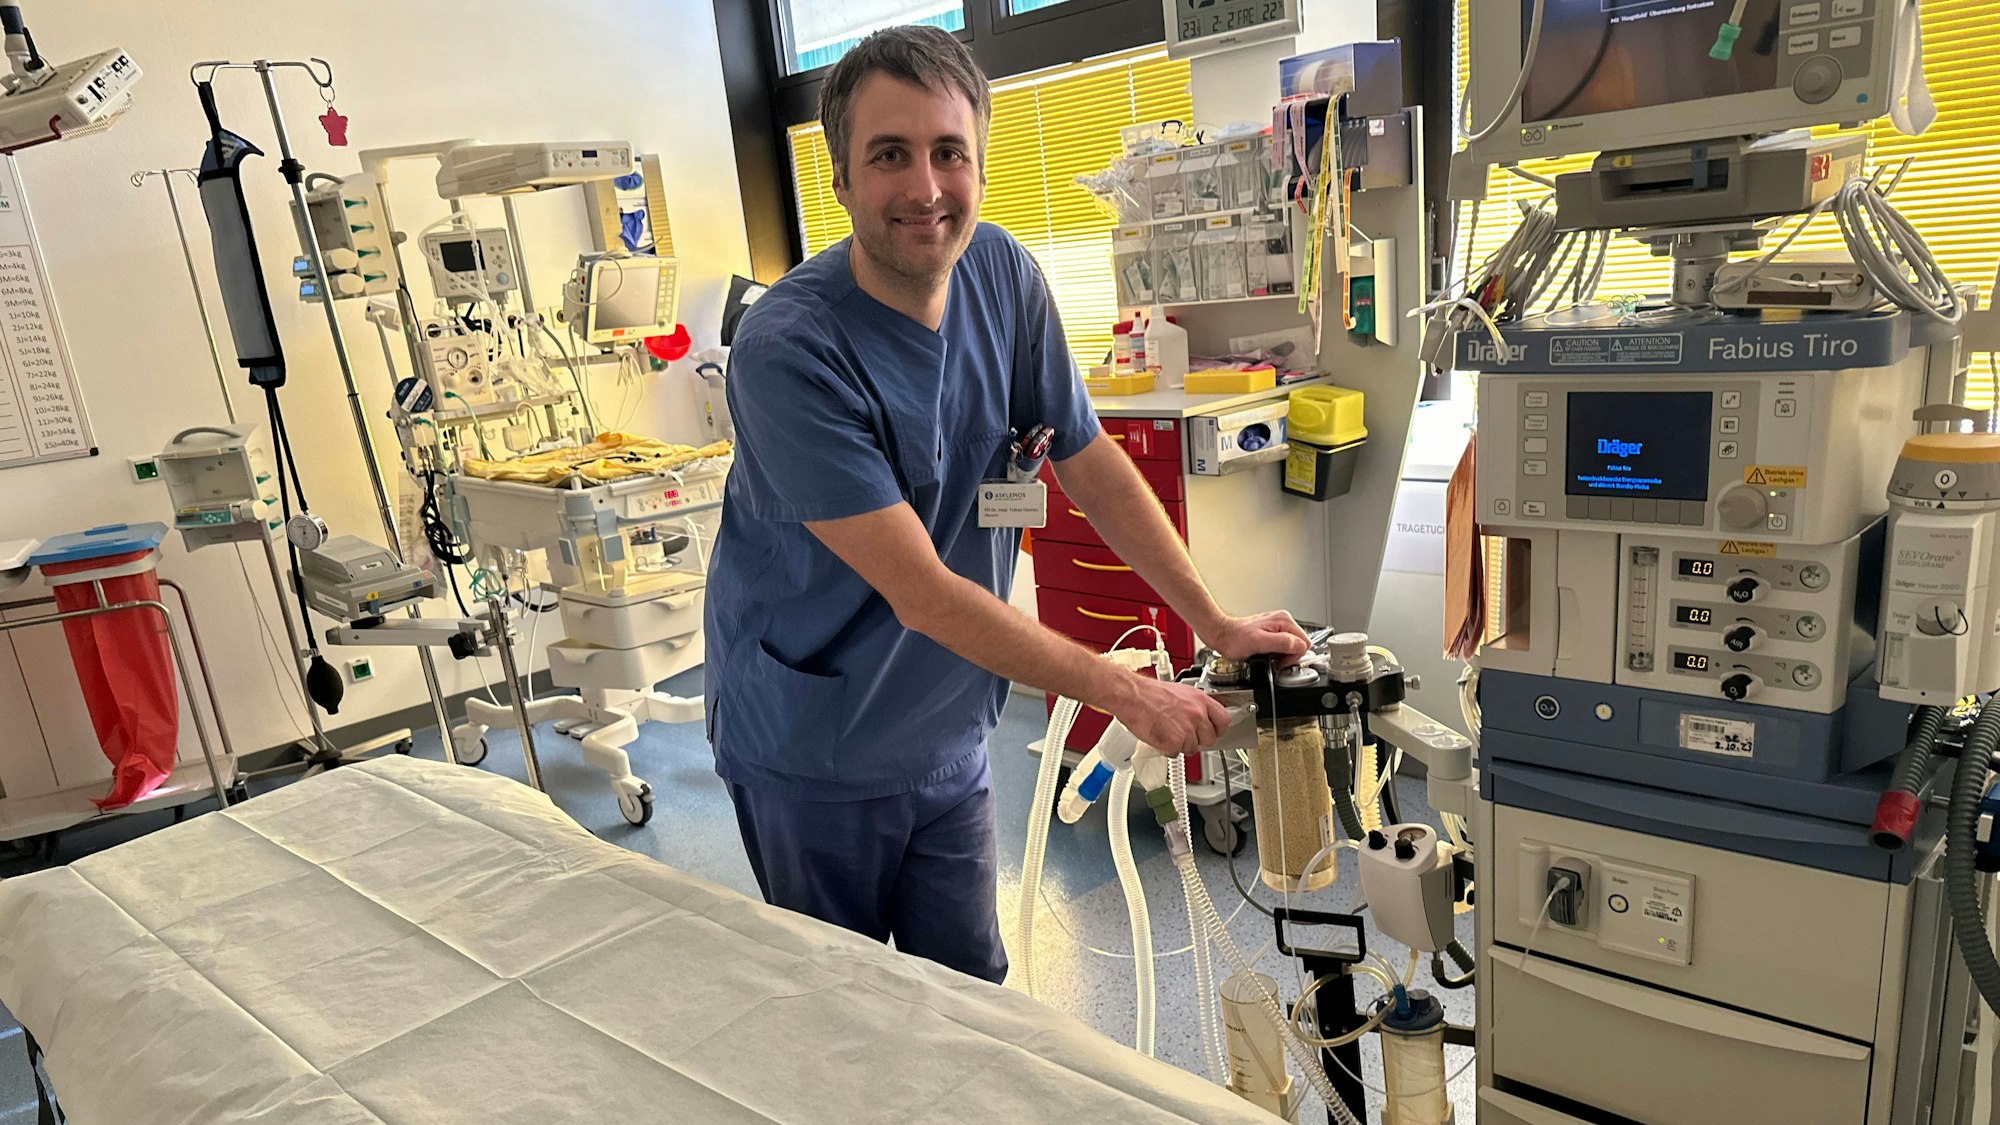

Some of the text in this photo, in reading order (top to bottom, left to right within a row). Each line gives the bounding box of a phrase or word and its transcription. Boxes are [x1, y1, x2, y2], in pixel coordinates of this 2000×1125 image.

[8, 310, 40, 320] 1J=10kg
[12, 323, 44, 332] 2J=12kg
[16, 335, 48, 344] 3J=14kg
[1628, 337, 1671, 345] ATTENTION
[19, 346, 51, 356] 5J=18kg
[1708, 334, 1858, 360] Fabius Tiro
[1468, 340, 1528, 366] Dräer
[22, 358, 54, 368] 6J=20kg
[26, 370, 58, 379] 7J=22kg
[30, 382, 61, 391] 8J=24kg
[32, 394, 64, 402] 9J=26kg
[34, 405, 70, 415] 10J=28kg
[38, 416, 73, 426] 11J=30kg
[1221, 435, 1232, 451] M
[1598, 438, 1643, 458] Dräger
[1397, 522, 1445, 535] TRAGETUC
[1898, 550, 1955, 562] SEVOrane
[1692, 562, 1713, 575] 0.0
[1689, 609, 1710, 622] 0.0
[1730, 638, 1744, 648] AIR
[1686, 656, 1707, 668] 0.0
